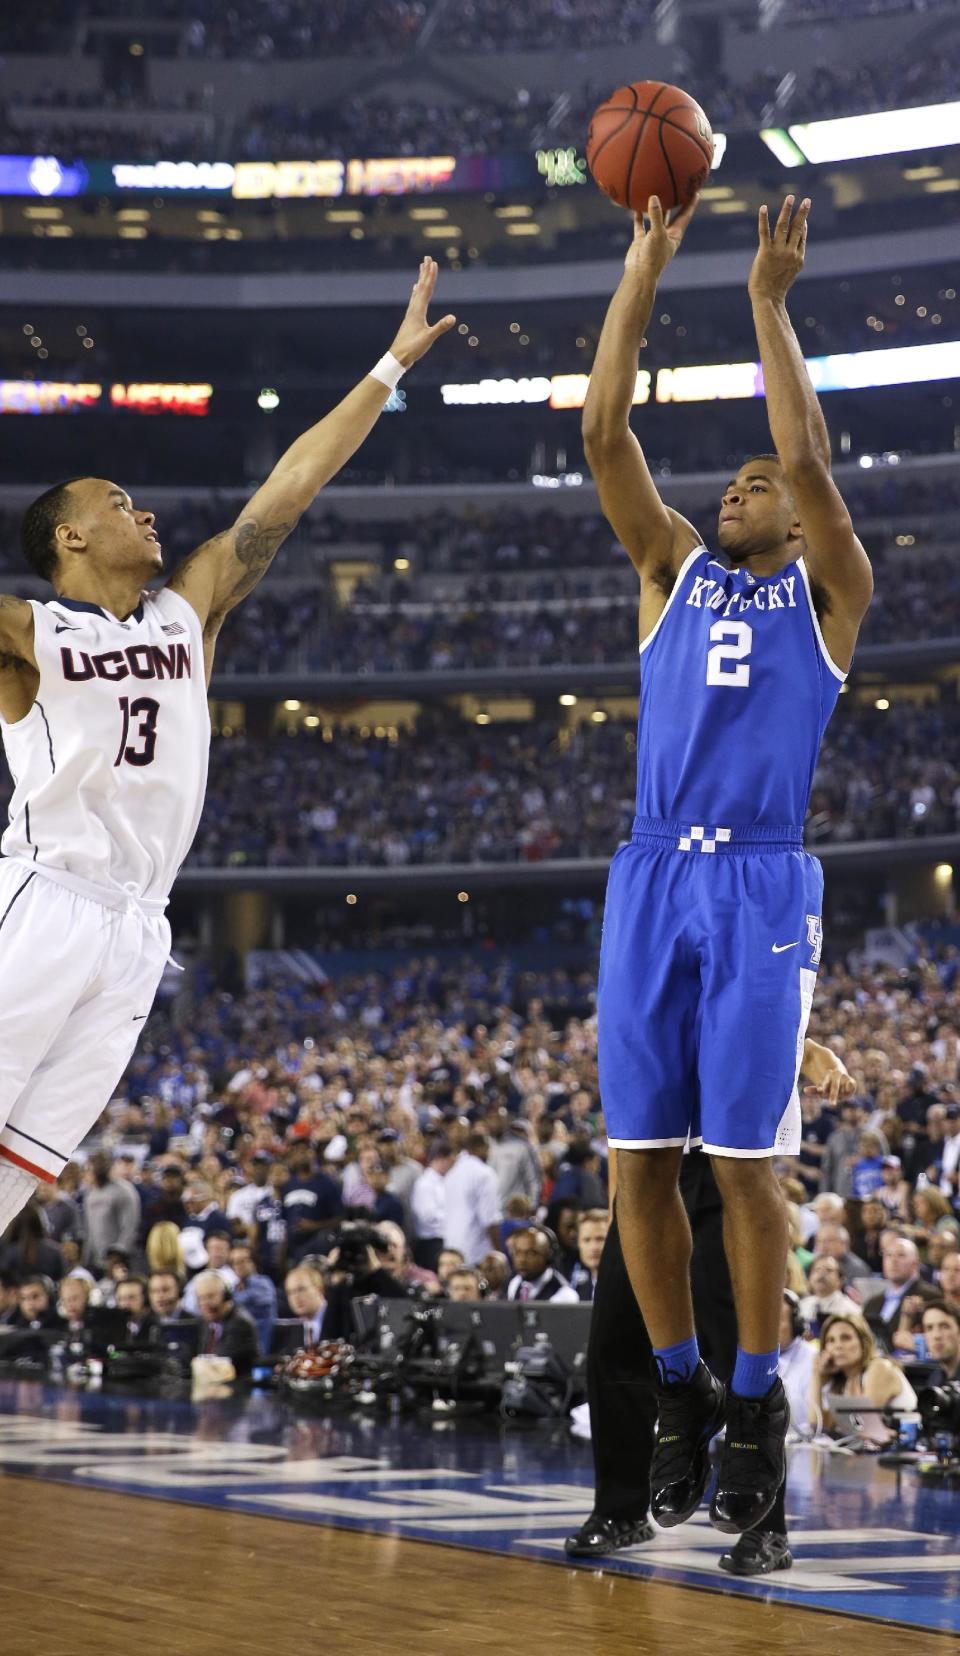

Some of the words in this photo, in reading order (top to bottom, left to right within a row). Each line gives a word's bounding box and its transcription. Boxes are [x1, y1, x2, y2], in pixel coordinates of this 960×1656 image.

[686, 575, 797, 617] KNTUCKY
[60, 643, 192, 682] UCONN
[706, 620, 753, 688] 2
[114, 696, 161, 768] 13
